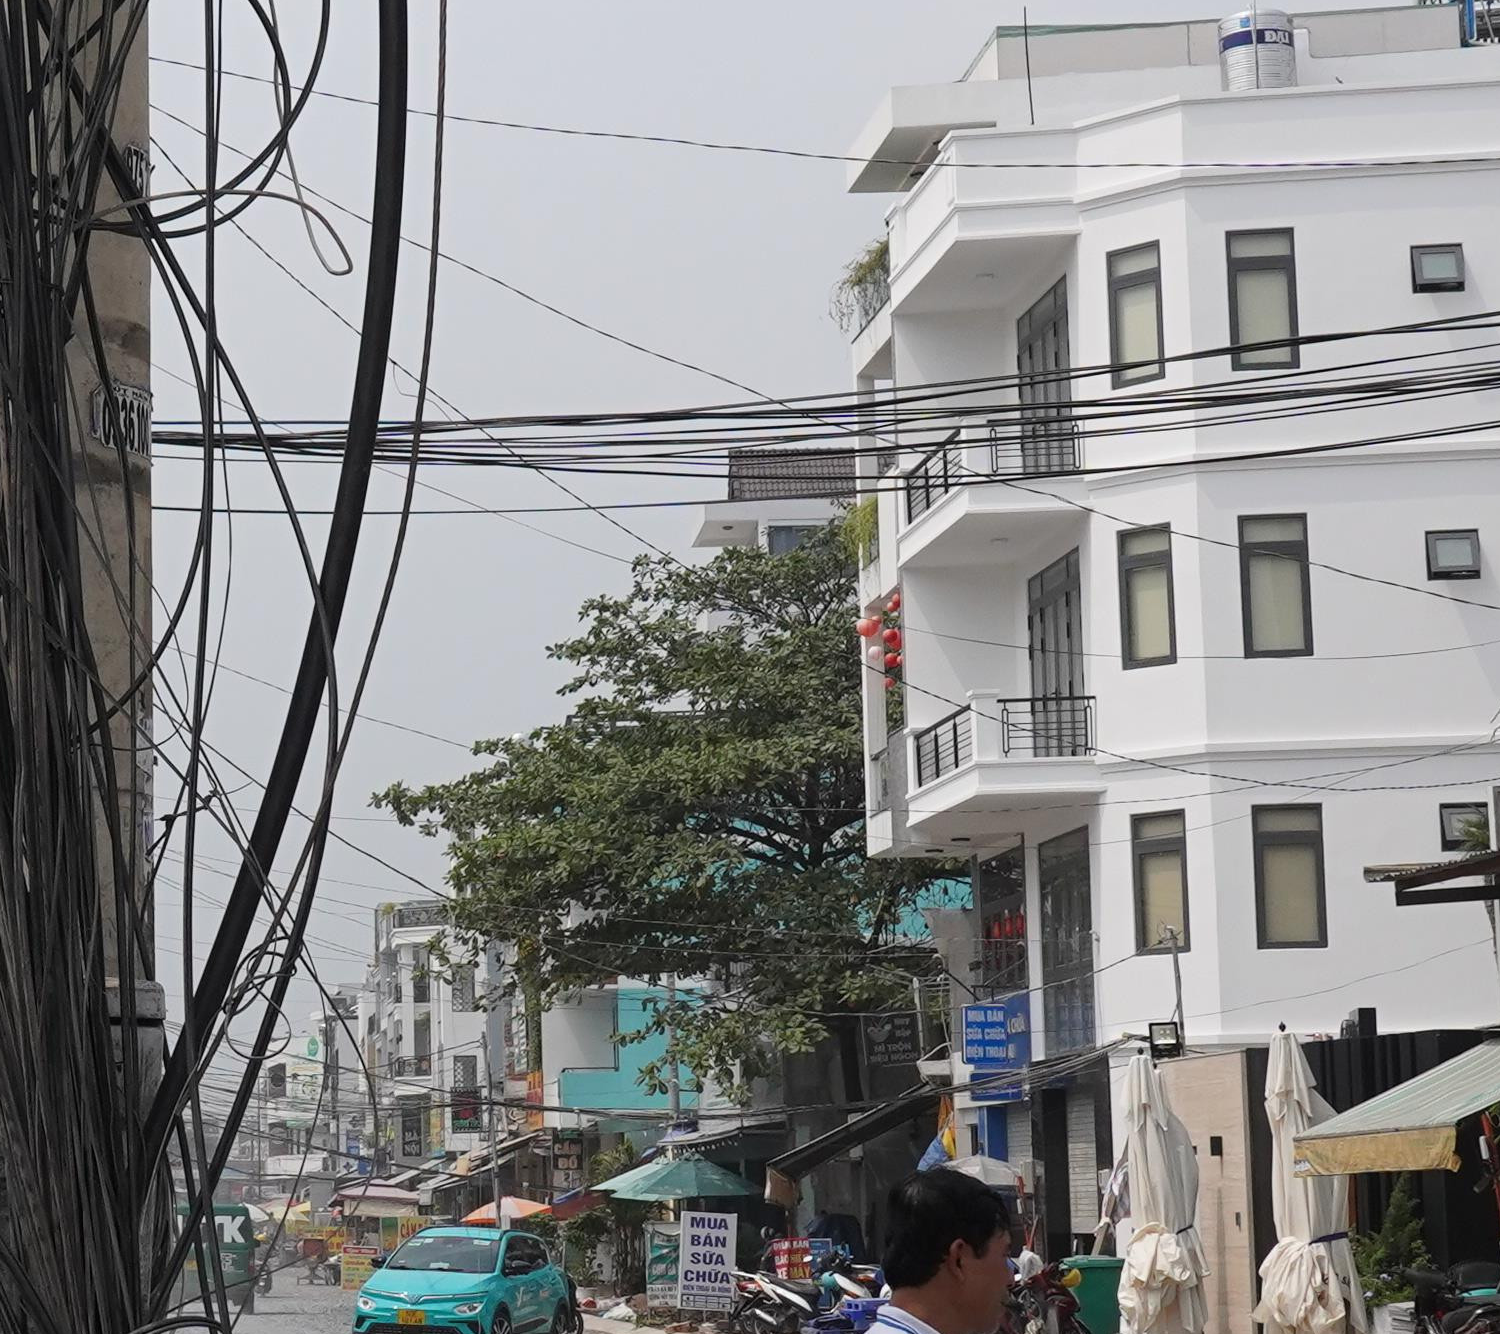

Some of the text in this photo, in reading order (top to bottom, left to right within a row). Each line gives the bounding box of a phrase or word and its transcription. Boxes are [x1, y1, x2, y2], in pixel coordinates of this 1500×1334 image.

[690, 1217, 729, 1230] MUA
[690, 1233, 727, 1248] BÁN
[683, 1269, 731, 1285] CHỮA
